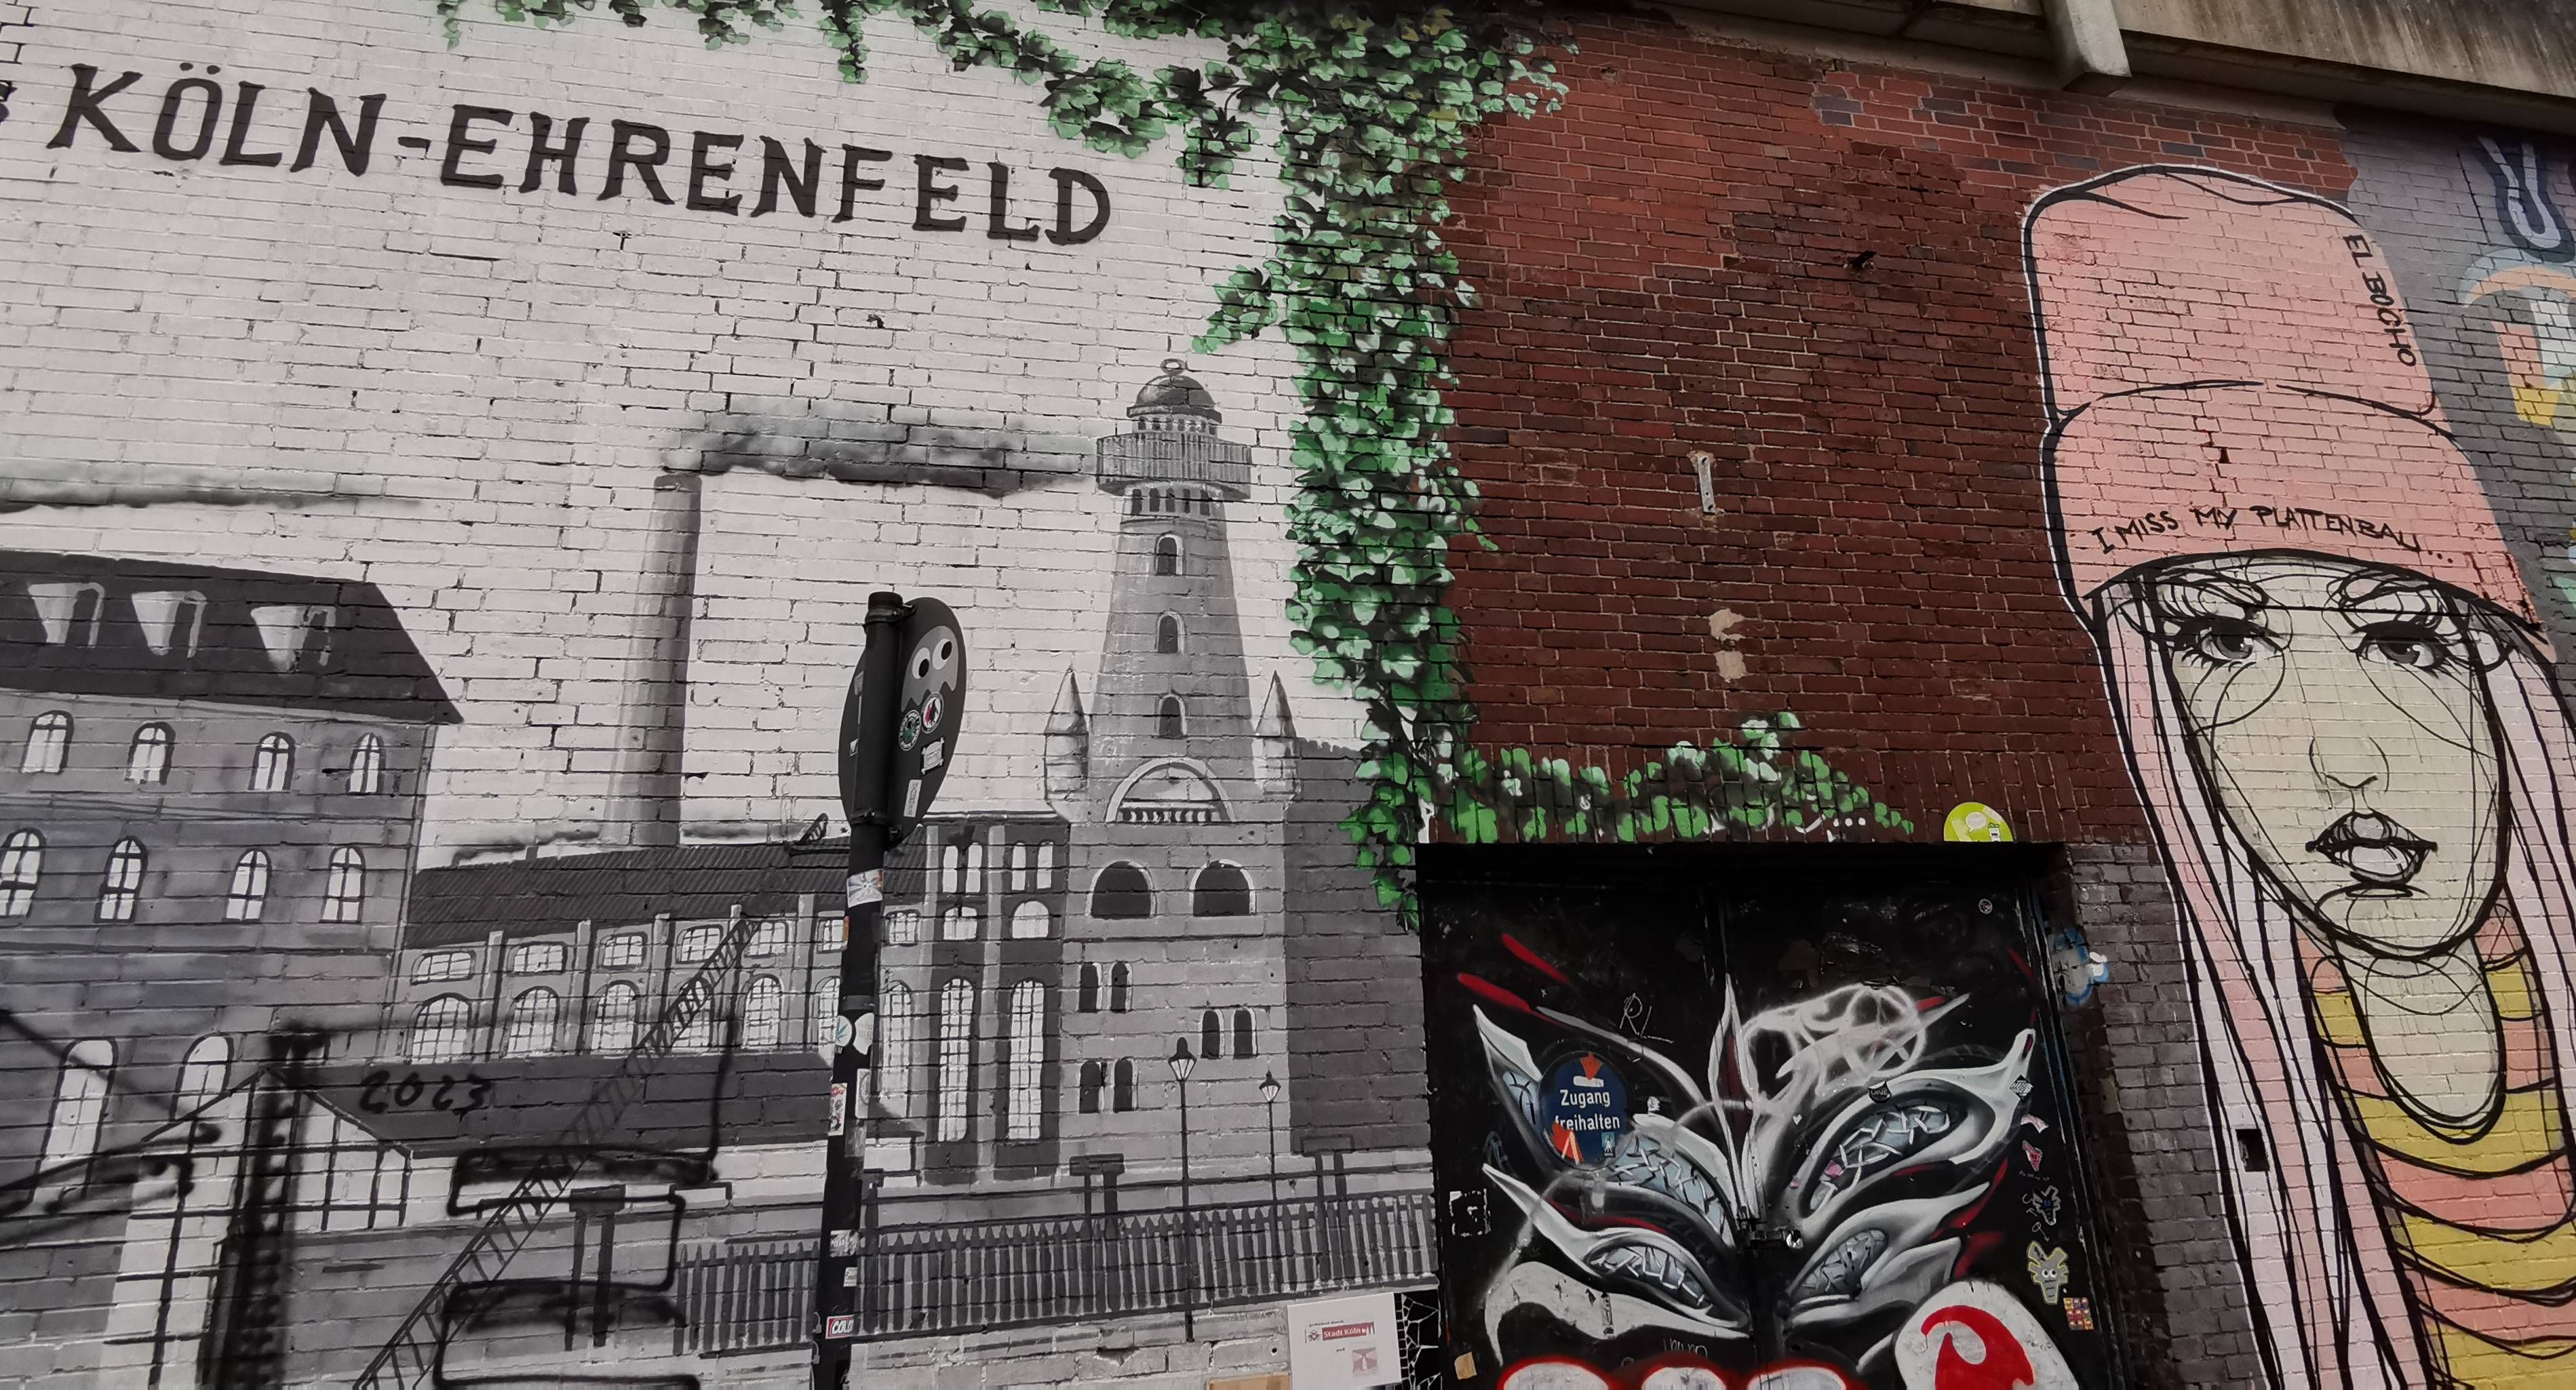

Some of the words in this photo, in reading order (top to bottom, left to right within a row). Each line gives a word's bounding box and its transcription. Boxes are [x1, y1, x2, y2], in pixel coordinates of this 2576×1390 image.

[46, 62, 1110, 245] KÖLN-EHRENFELD
[2343, 235, 2373, 269] EL
[2362, 271, 2417, 367] BOCHO
[2115, 510, 2179, 543] MISS
[2190, 507, 2237, 530] MY
[359, 1070, 492, 1117] 2023
[1560, 1089, 1610, 1109] Zugang
[1324, 1329, 1344, 1338] Stadt
